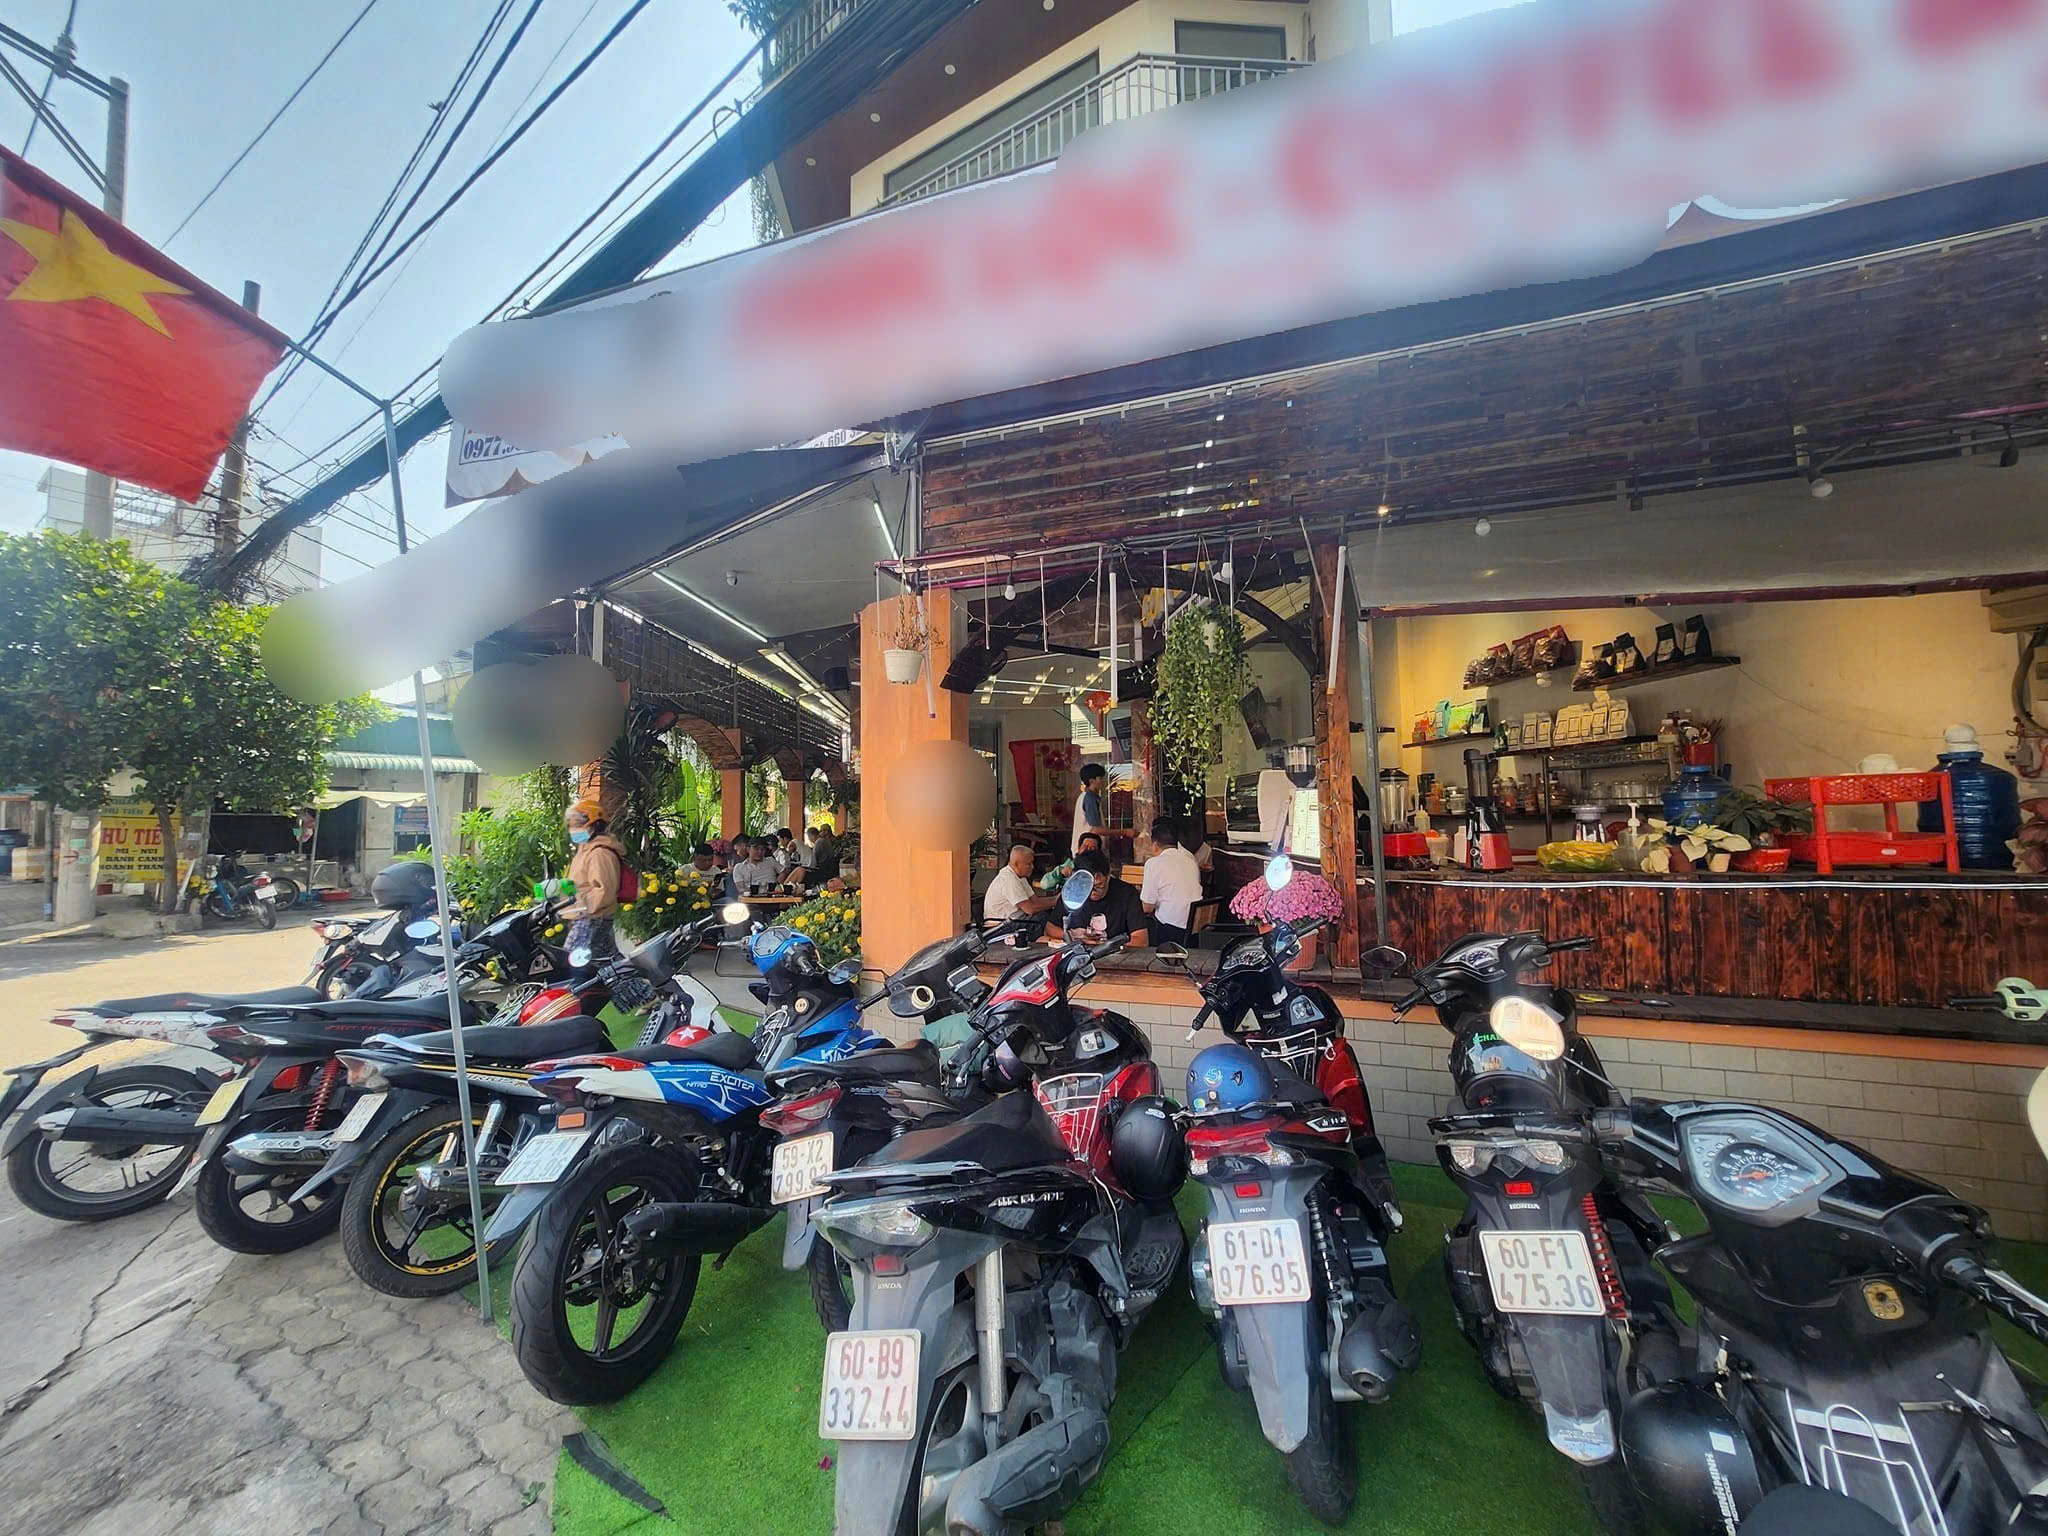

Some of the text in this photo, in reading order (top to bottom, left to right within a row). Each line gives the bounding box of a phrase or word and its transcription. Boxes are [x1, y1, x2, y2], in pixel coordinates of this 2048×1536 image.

[710, 1071, 755, 1092] EXCITER
[782, 1139, 824, 1169] 59-X2
[1239, 1206, 1266, 1214] HONDA
[1224, 1227, 1285, 1260] 61-D1
[1498, 1238, 1572, 1269] 60-F1
[1220, 1262, 1302, 1297] 976.95
[1500, 1273, 1595, 1307] 475.36
[840, 1338, 905, 1380] 60-B9
[827, 1386, 909, 1429] 332.44
